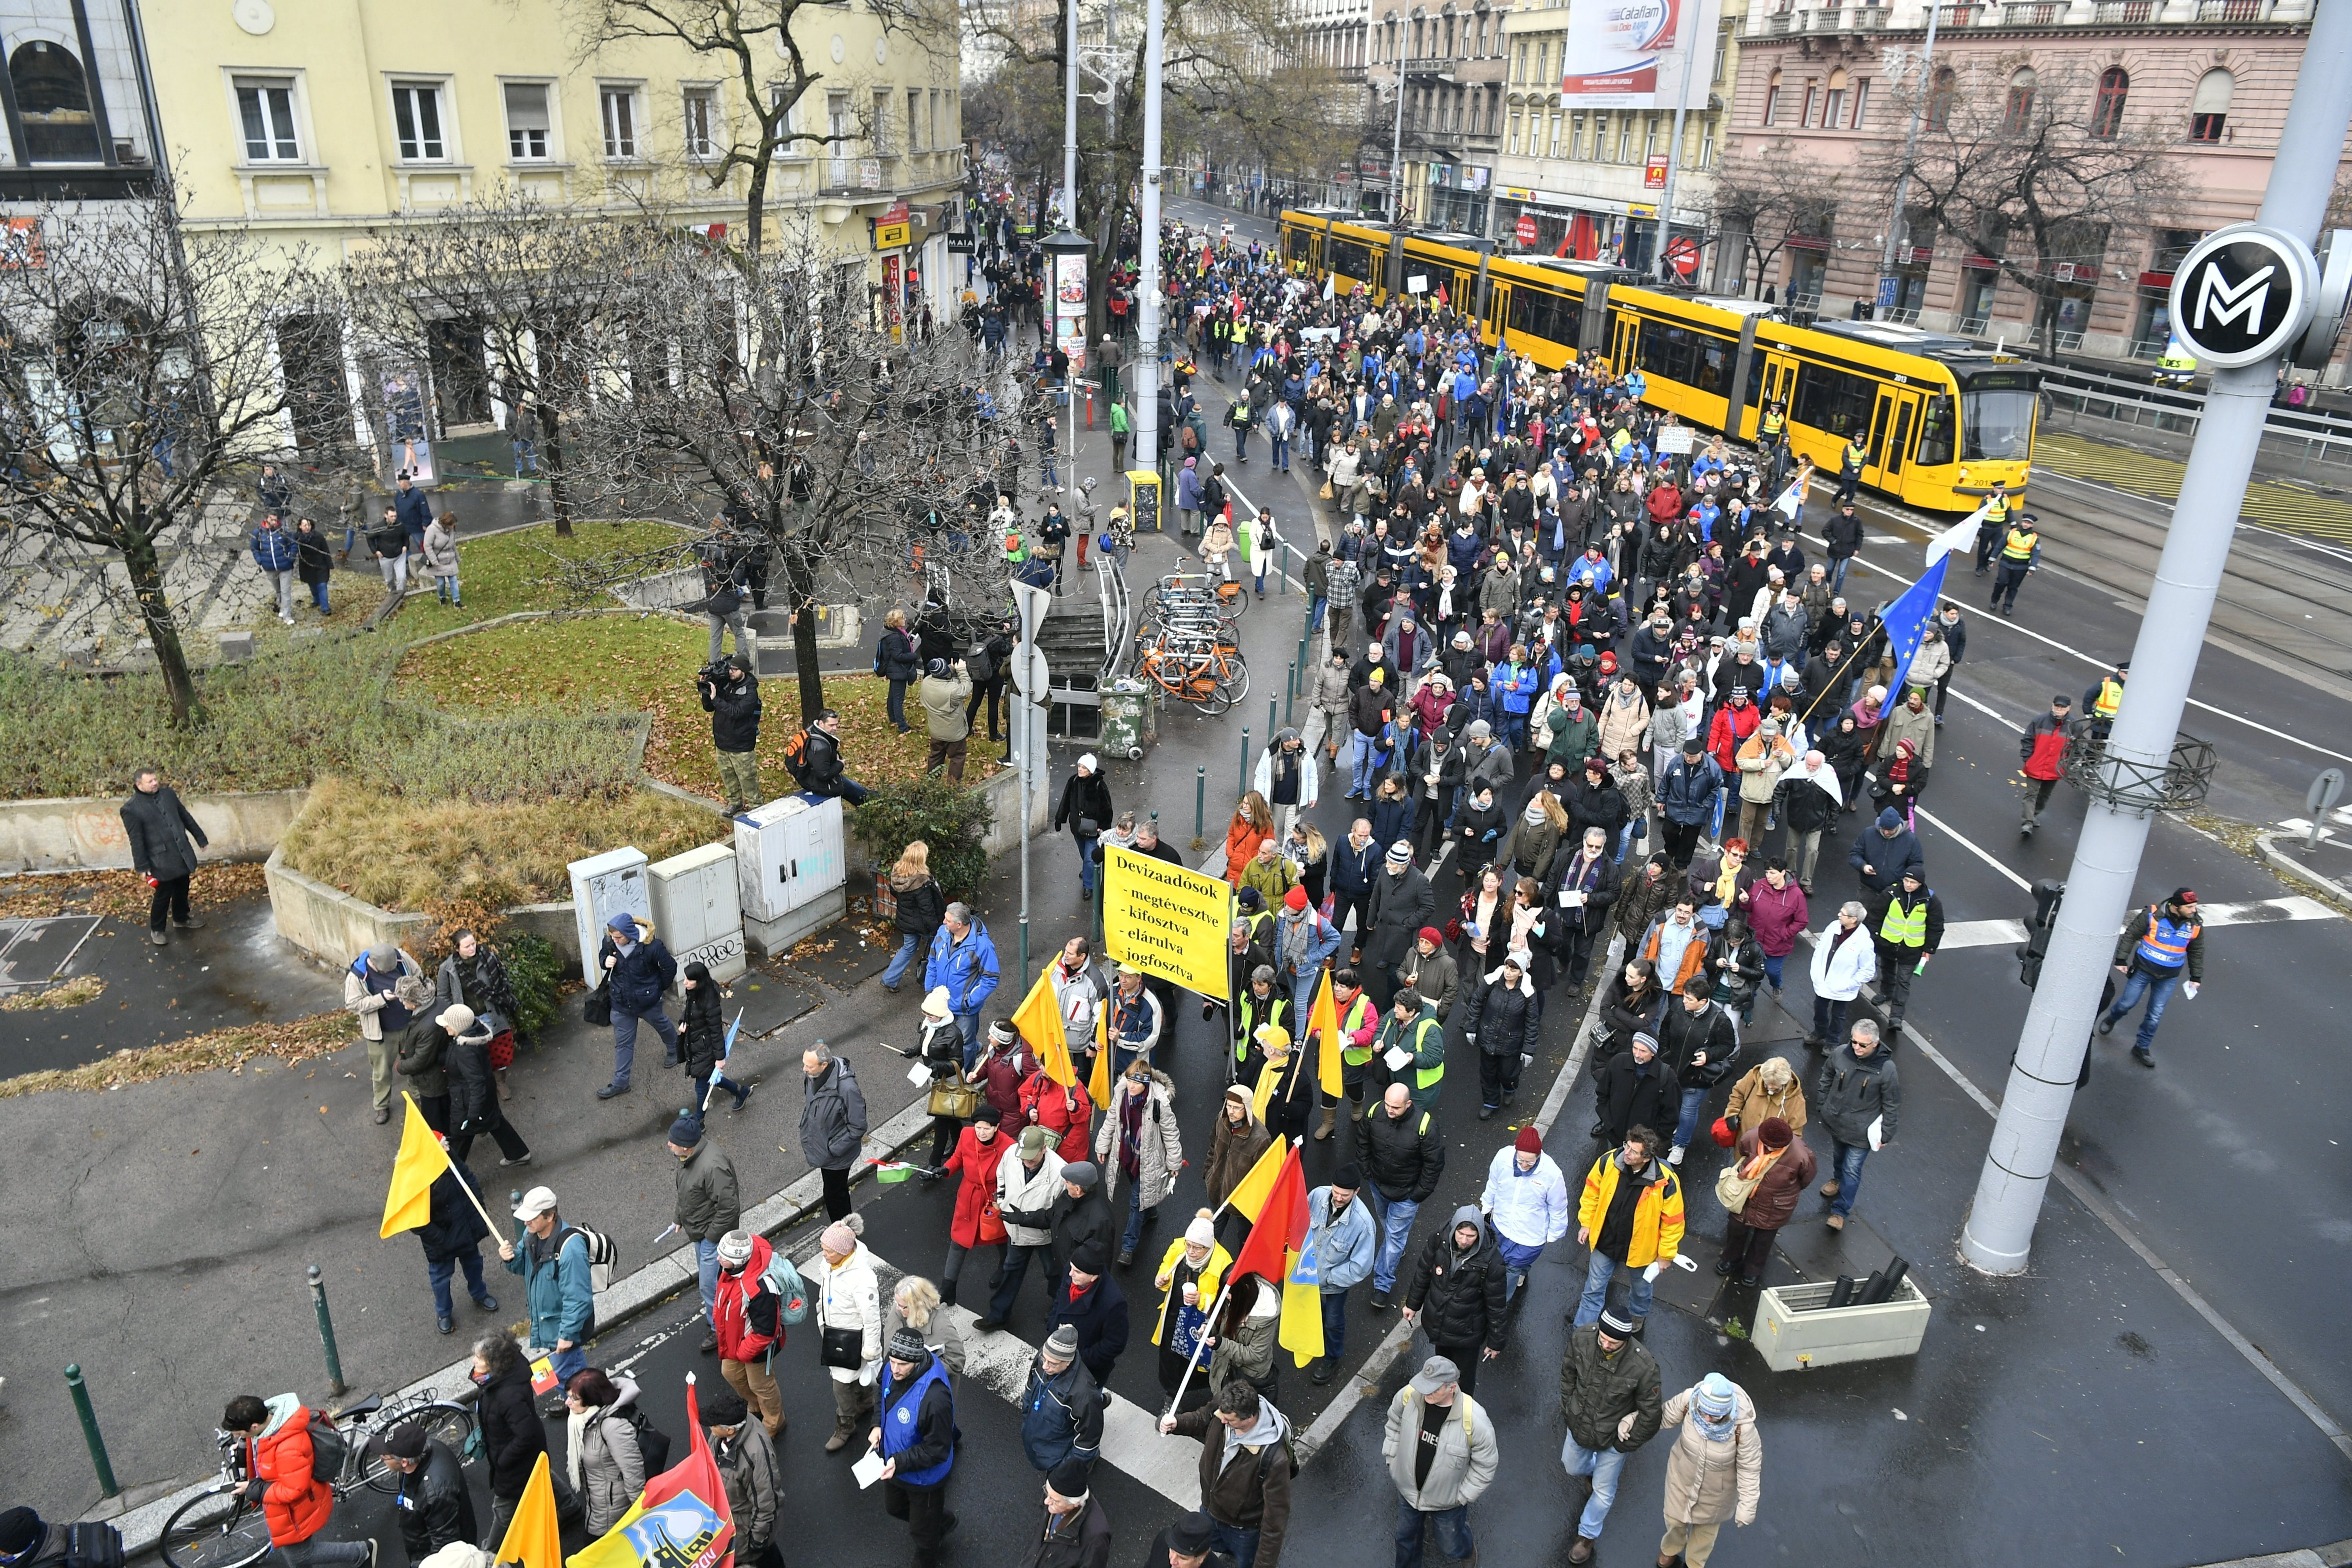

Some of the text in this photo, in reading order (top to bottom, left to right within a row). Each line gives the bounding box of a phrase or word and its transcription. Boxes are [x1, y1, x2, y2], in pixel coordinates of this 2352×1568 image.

[1620, 5, 1659, 20] Cataflam
[890, 258, 899, 323] CHAE
[1894, 373, 1908, 384] 2013
[1116, 855, 1219, 900] Devizaadósok
[1129, 905, 1189, 936] kifosztva
[1131, 889, 1219, 928] megtévesztve
[1128, 928, 1183, 956] elárulva
[1126, 947, 1193, 982] jogfosztva
